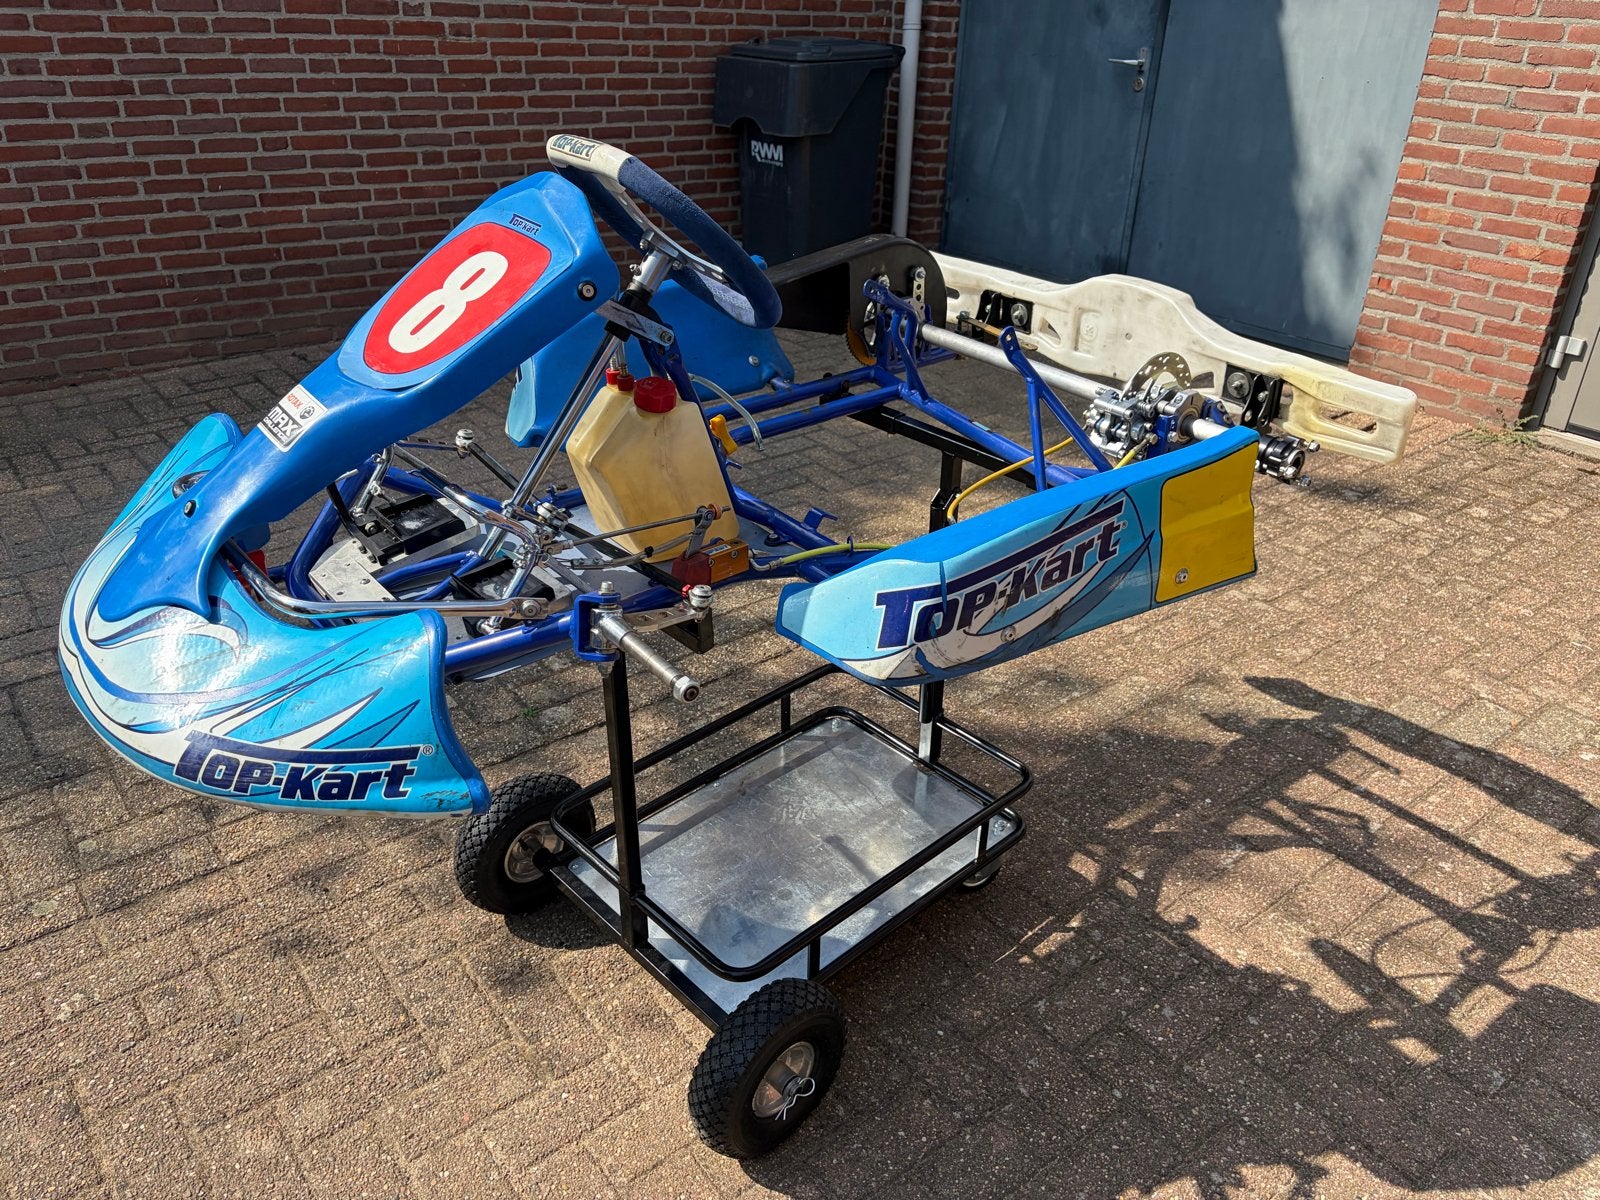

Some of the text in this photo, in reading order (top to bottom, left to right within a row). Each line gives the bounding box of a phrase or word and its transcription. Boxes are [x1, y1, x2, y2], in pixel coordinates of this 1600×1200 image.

[751, 140, 783, 162] RWM
[388, 251, 508, 353] 8
[267, 406, 298, 436] MAX
